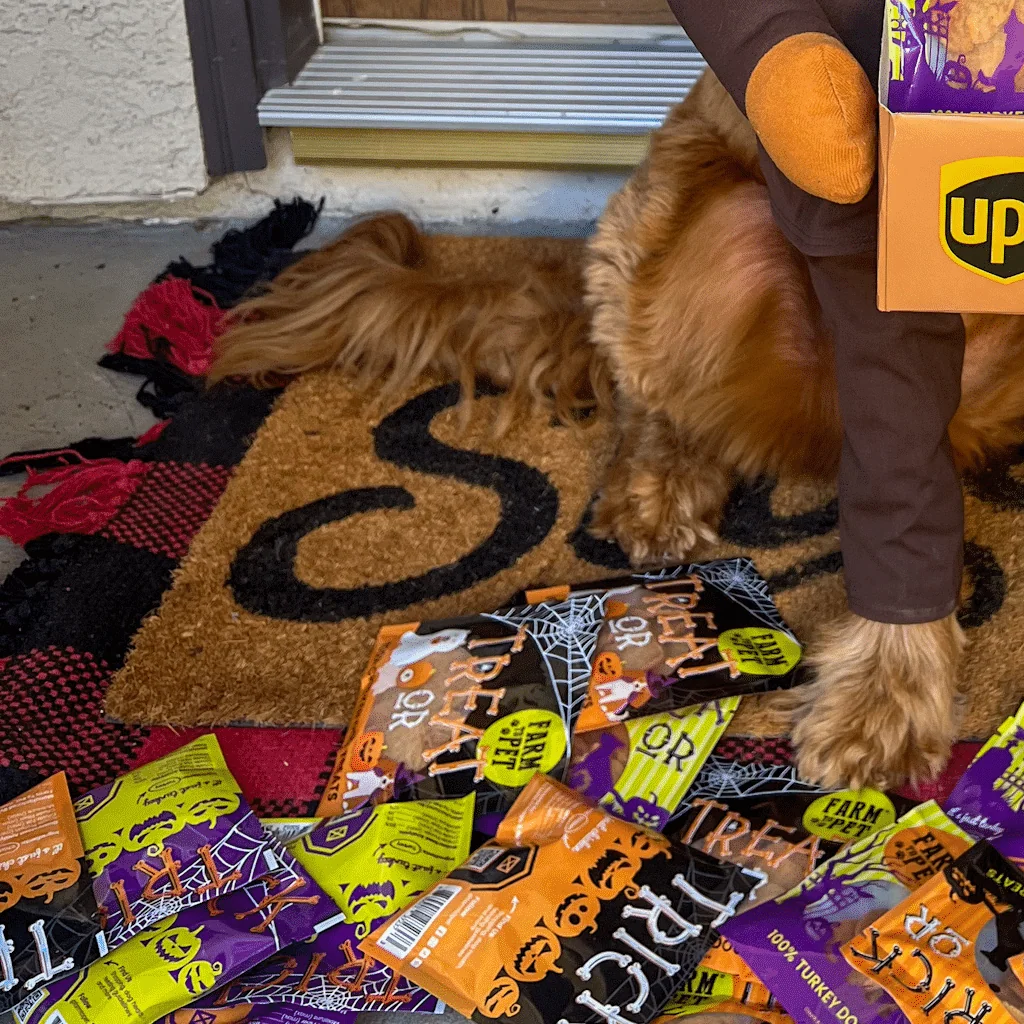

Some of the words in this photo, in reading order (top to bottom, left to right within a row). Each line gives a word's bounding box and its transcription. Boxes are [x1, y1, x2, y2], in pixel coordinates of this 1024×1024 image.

[609, 616, 653, 650] OR
[641, 575, 741, 679] TREAT
[751, 633, 788, 667] FARM
[737, 640, 760, 665] PET
[388, 689, 436, 731] OR
[421, 624, 528, 783] TREAT
[492, 735, 521, 771] PET
[517, 719, 552, 772] FARM
[636, 723, 695, 774] OR
[822, 797, 883, 824] FARM
[831, 818, 872, 838] PET
[681, 798, 848, 876] TREA
[913, 831, 954, 873] FAR
[99, 844, 242, 929] TRI
[903, 854, 936, 880] PE
[904, 903, 972, 958] OR
[766, 929, 799, 964] 100%
[794, 957, 842, 1010] TURKEY
[835, 1004, 860, 1024] DO
[849, 927, 993, 1024] RICK
